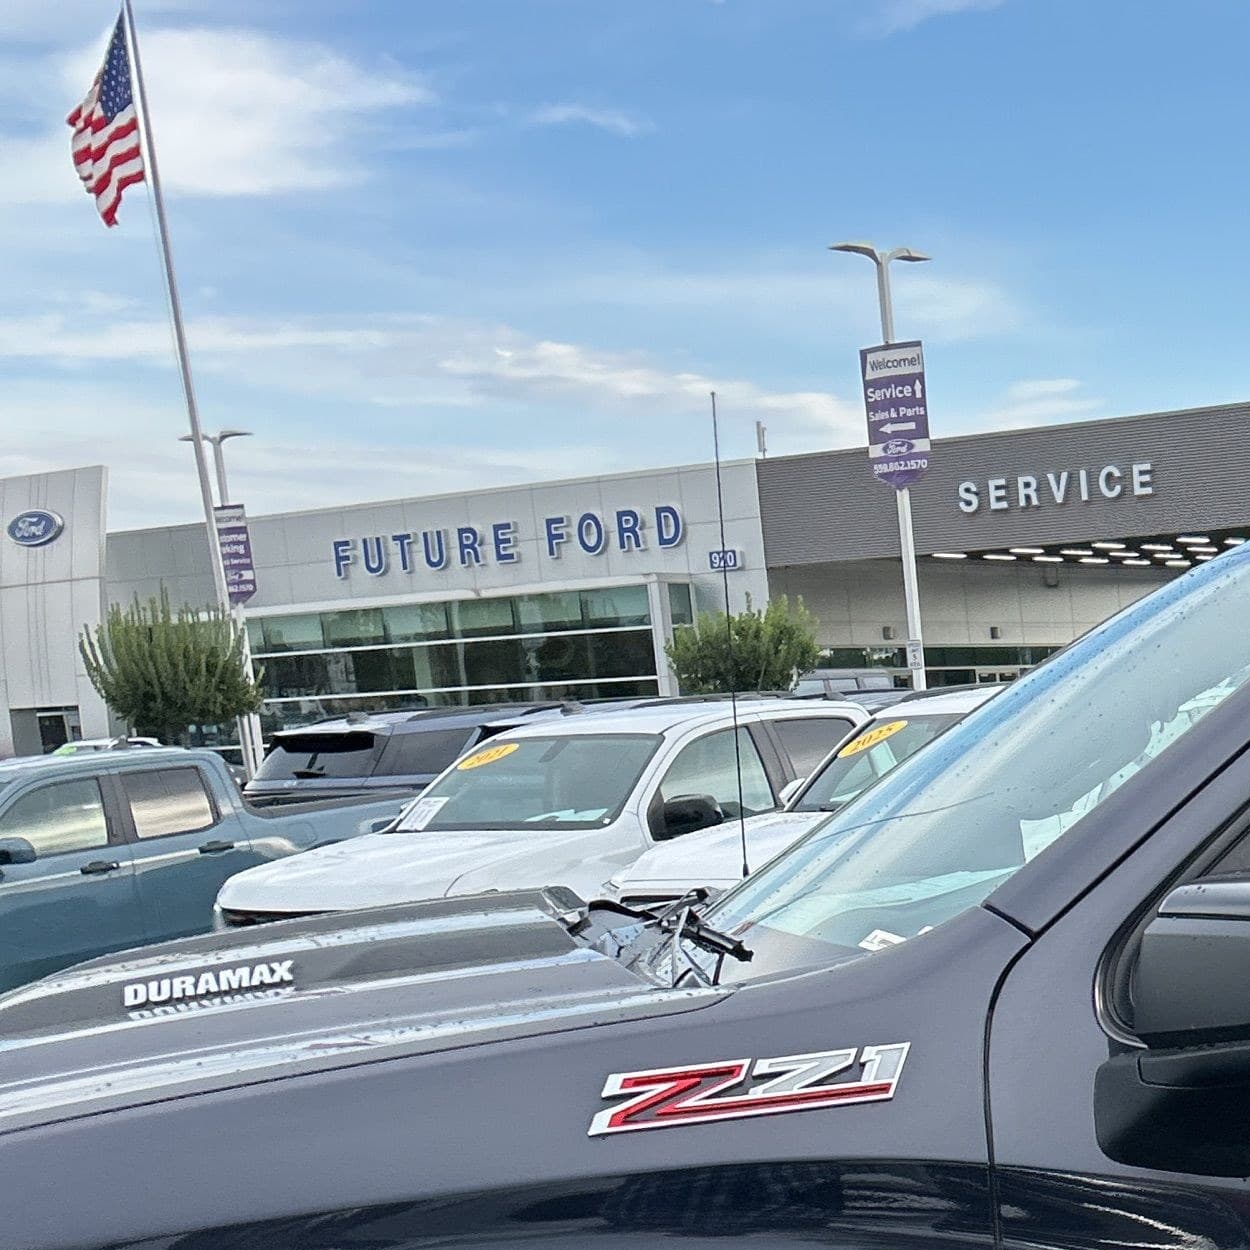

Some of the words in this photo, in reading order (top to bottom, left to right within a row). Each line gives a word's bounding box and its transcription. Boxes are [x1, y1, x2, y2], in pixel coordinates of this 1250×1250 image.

[869, 353, 921, 371] Welcome!
[867, 384, 912, 402] Service
[868, 410, 890, 421] Sales
[890, 407, 898, 418] &
[899, 406, 925, 417] Parts
[958, 463, 1153, 513] SERVICE
[333, 522, 518, 578] FUTURE
[545, 505, 682, 558] FORD
[711, 551, 735, 567] 920
[850, 727, 894, 751] 2025
[124, 960, 294, 1006] DURAMAX
[588, 1042, 911, 1136] Z71
